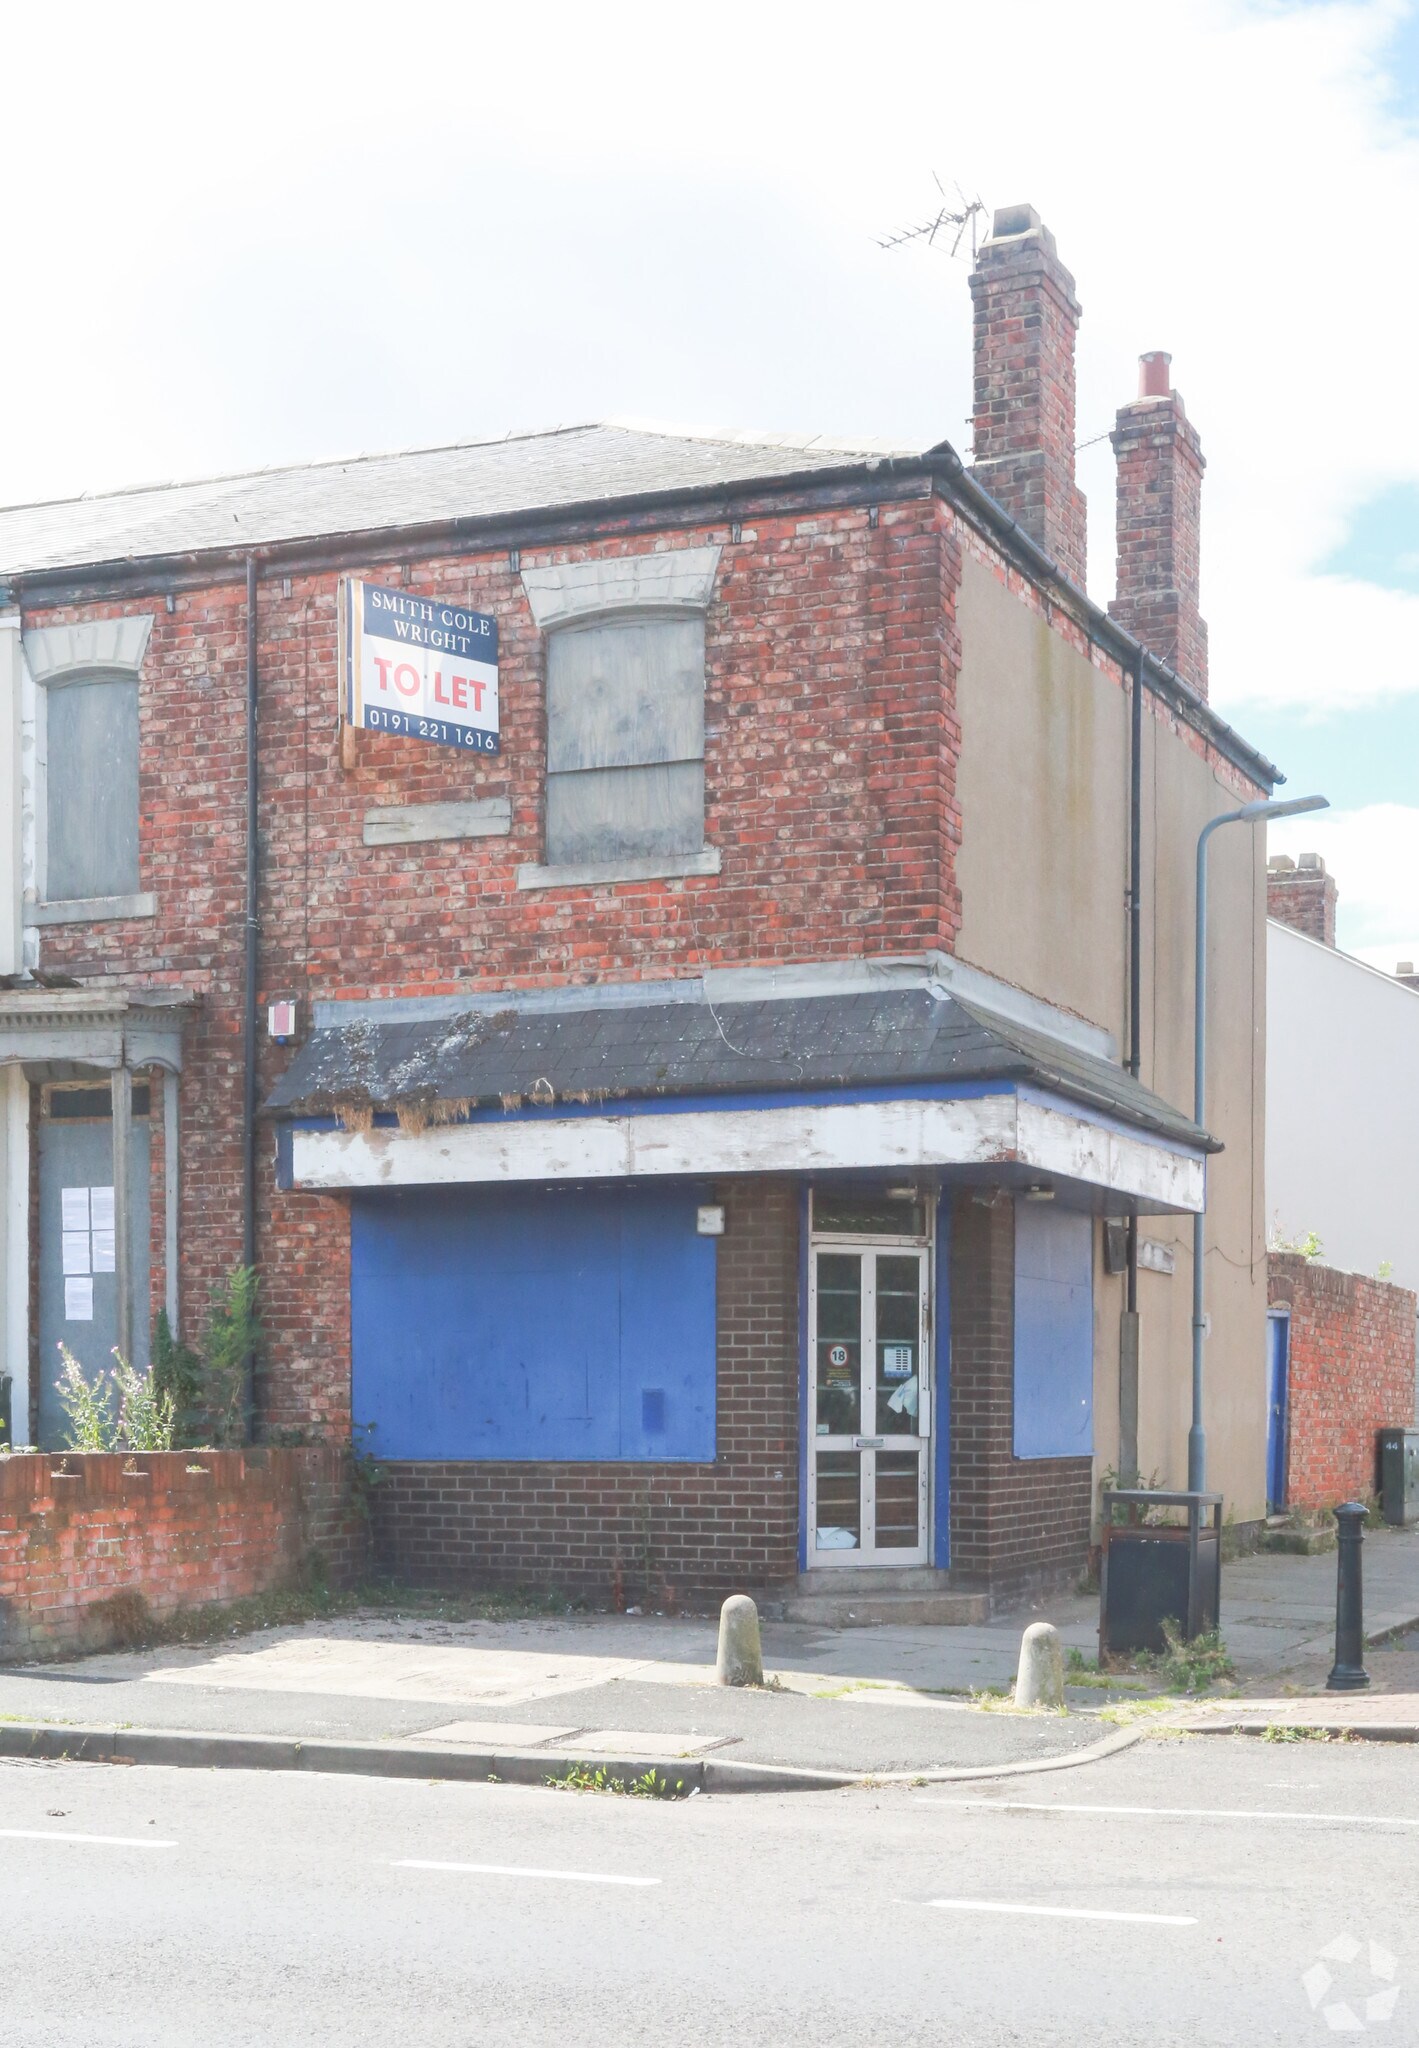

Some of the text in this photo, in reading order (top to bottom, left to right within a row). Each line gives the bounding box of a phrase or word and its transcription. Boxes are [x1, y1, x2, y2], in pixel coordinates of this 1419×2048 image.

[372, 591, 490, 636] SMITH COLE
[393, 619, 470, 653] WRIGHT
[374, 657, 486, 712] TO LET
[370, 710, 494, 749] 0191 221 1616
[832, 1350, 845, 1361] 18
